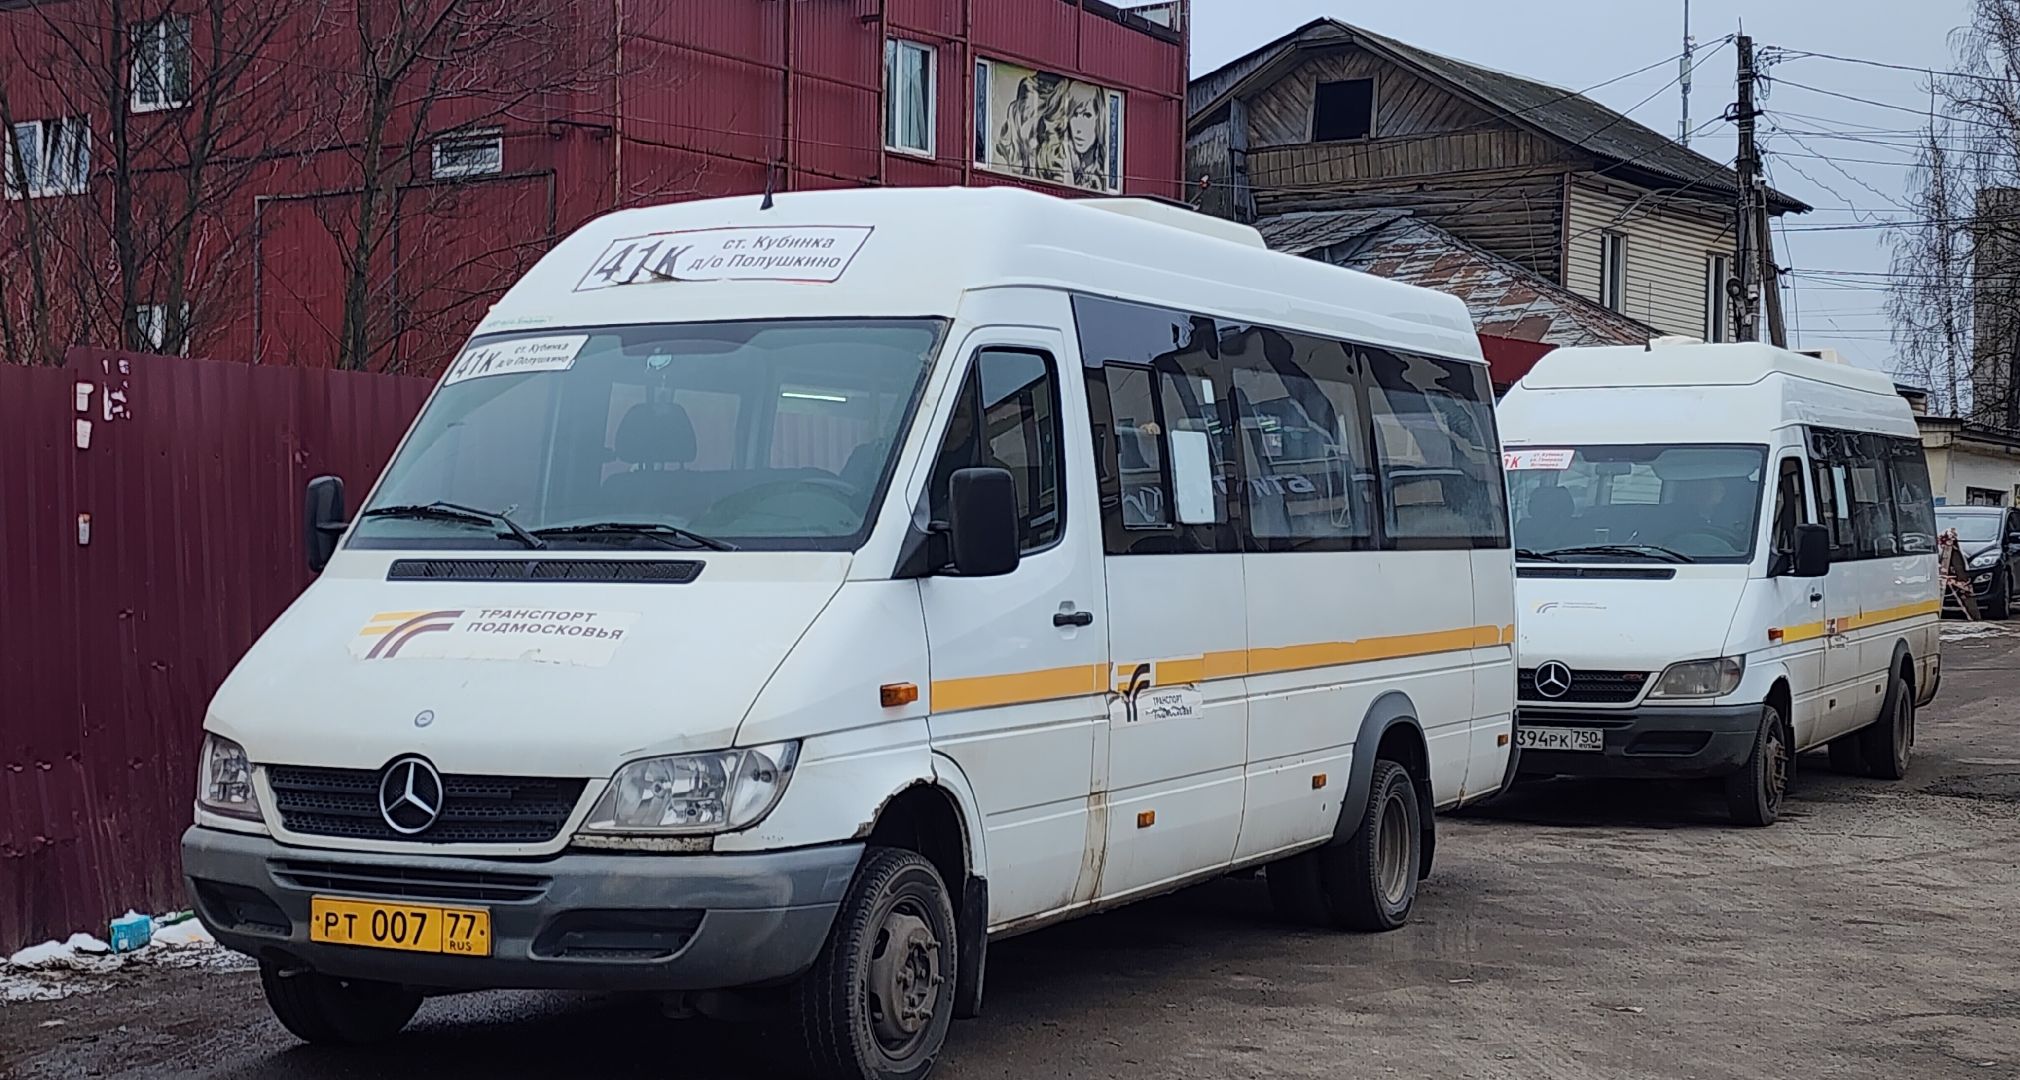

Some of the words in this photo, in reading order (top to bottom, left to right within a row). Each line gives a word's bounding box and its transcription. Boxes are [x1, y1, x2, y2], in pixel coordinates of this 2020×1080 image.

[722, 238, 746, 250] ст.
[752, 235, 835, 250] Кубинка
[594, 240, 694, 284] 41К
[687, 254, 724, 271] д/о
[726, 252, 842, 269] Полушкино
[456, 348, 502, 379] 41К
[478, 609, 597, 622] ТРАНСПОРТ
[466, 622, 624, 640] ПОДМОСКОВЬЯ
[1573, 731, 1598, 743] 750
[372, 909, 427, 945] 007
[447, 913, 476, 939] 77
[450, 941, 472, 951] RUS
